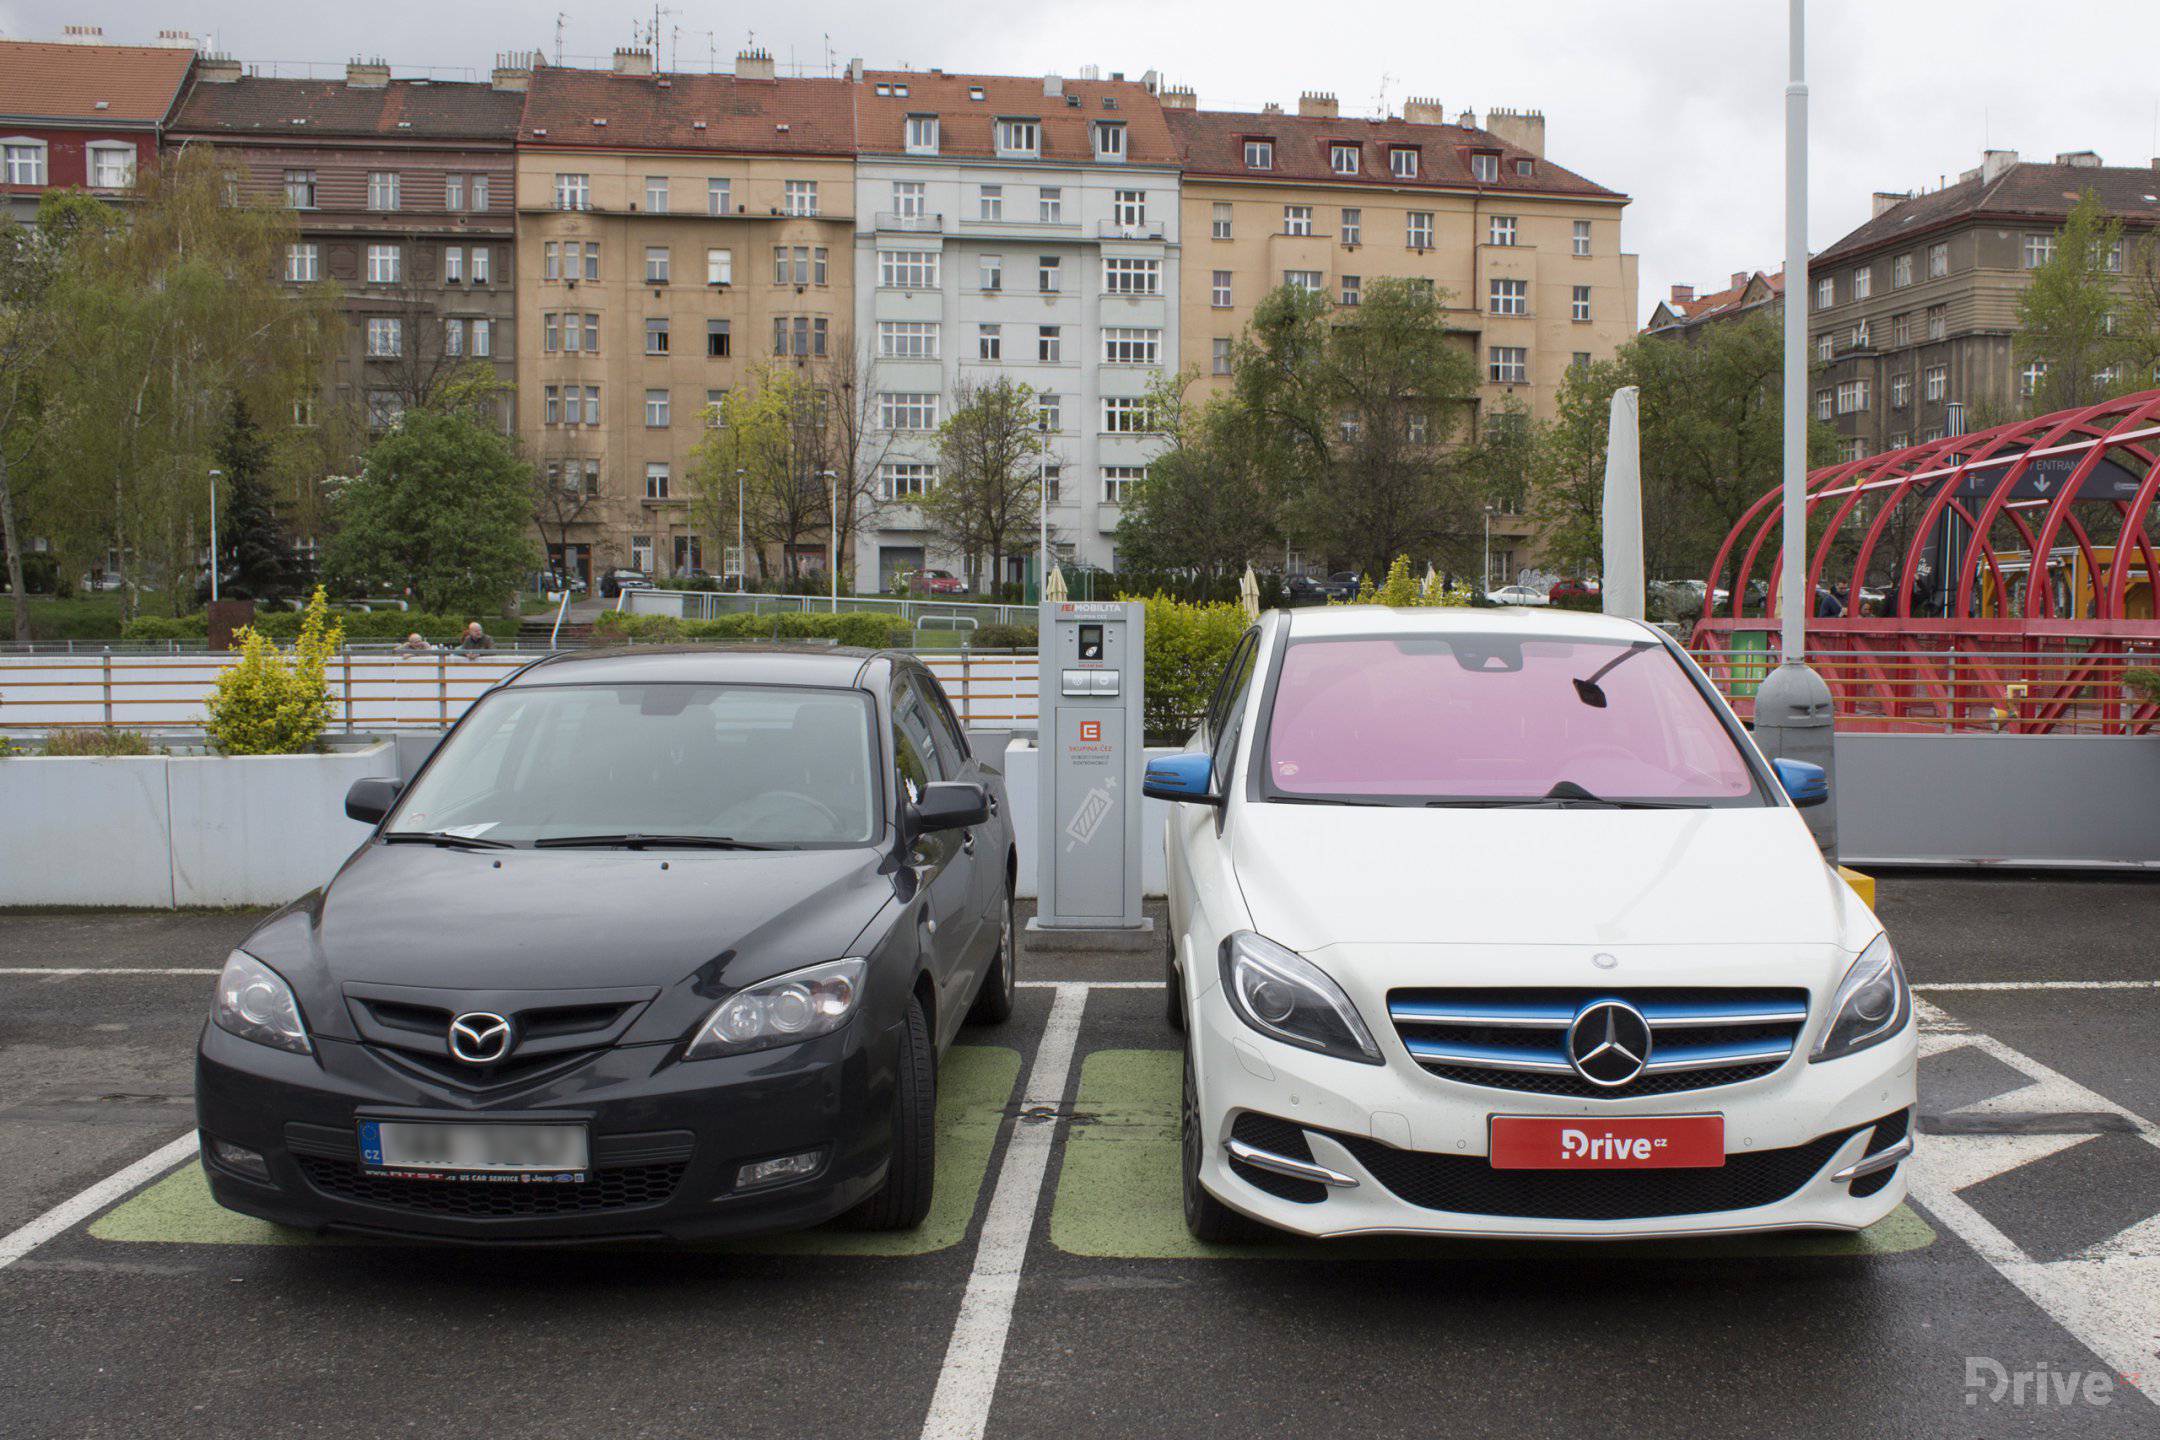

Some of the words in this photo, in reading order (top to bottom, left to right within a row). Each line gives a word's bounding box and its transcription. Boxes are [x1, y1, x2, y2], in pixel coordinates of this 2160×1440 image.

[2036, 460, 2079, 471] ENTRAN
[1562, 1129, 1651, 1160] Drive
[364, 1149, 381, 1160] CZ
[489, 1174, 519, 1182] SERVICE
